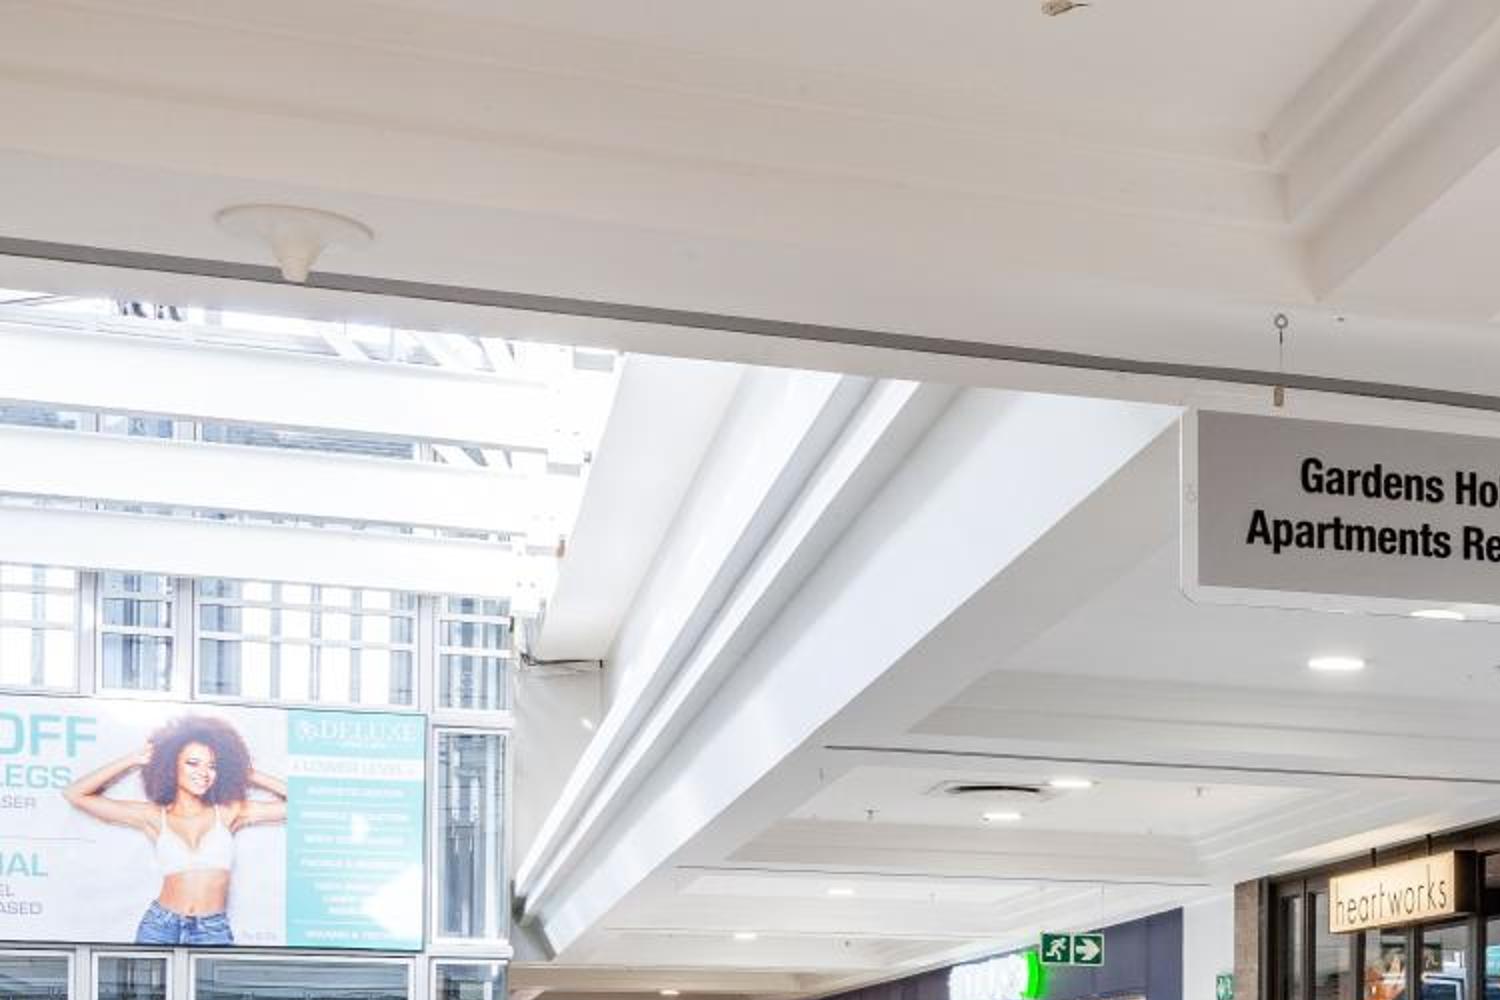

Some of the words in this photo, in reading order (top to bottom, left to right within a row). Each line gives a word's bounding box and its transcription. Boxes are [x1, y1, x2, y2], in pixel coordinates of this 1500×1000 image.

[1299, 456, 1444, 504] Gardens
[1246, 508, 1452, 560] Apartments
[0, 763, 72, 789] EGS
[0, 795, 36, 809] SER
[1335, 864, 1447, 926] heartworks
